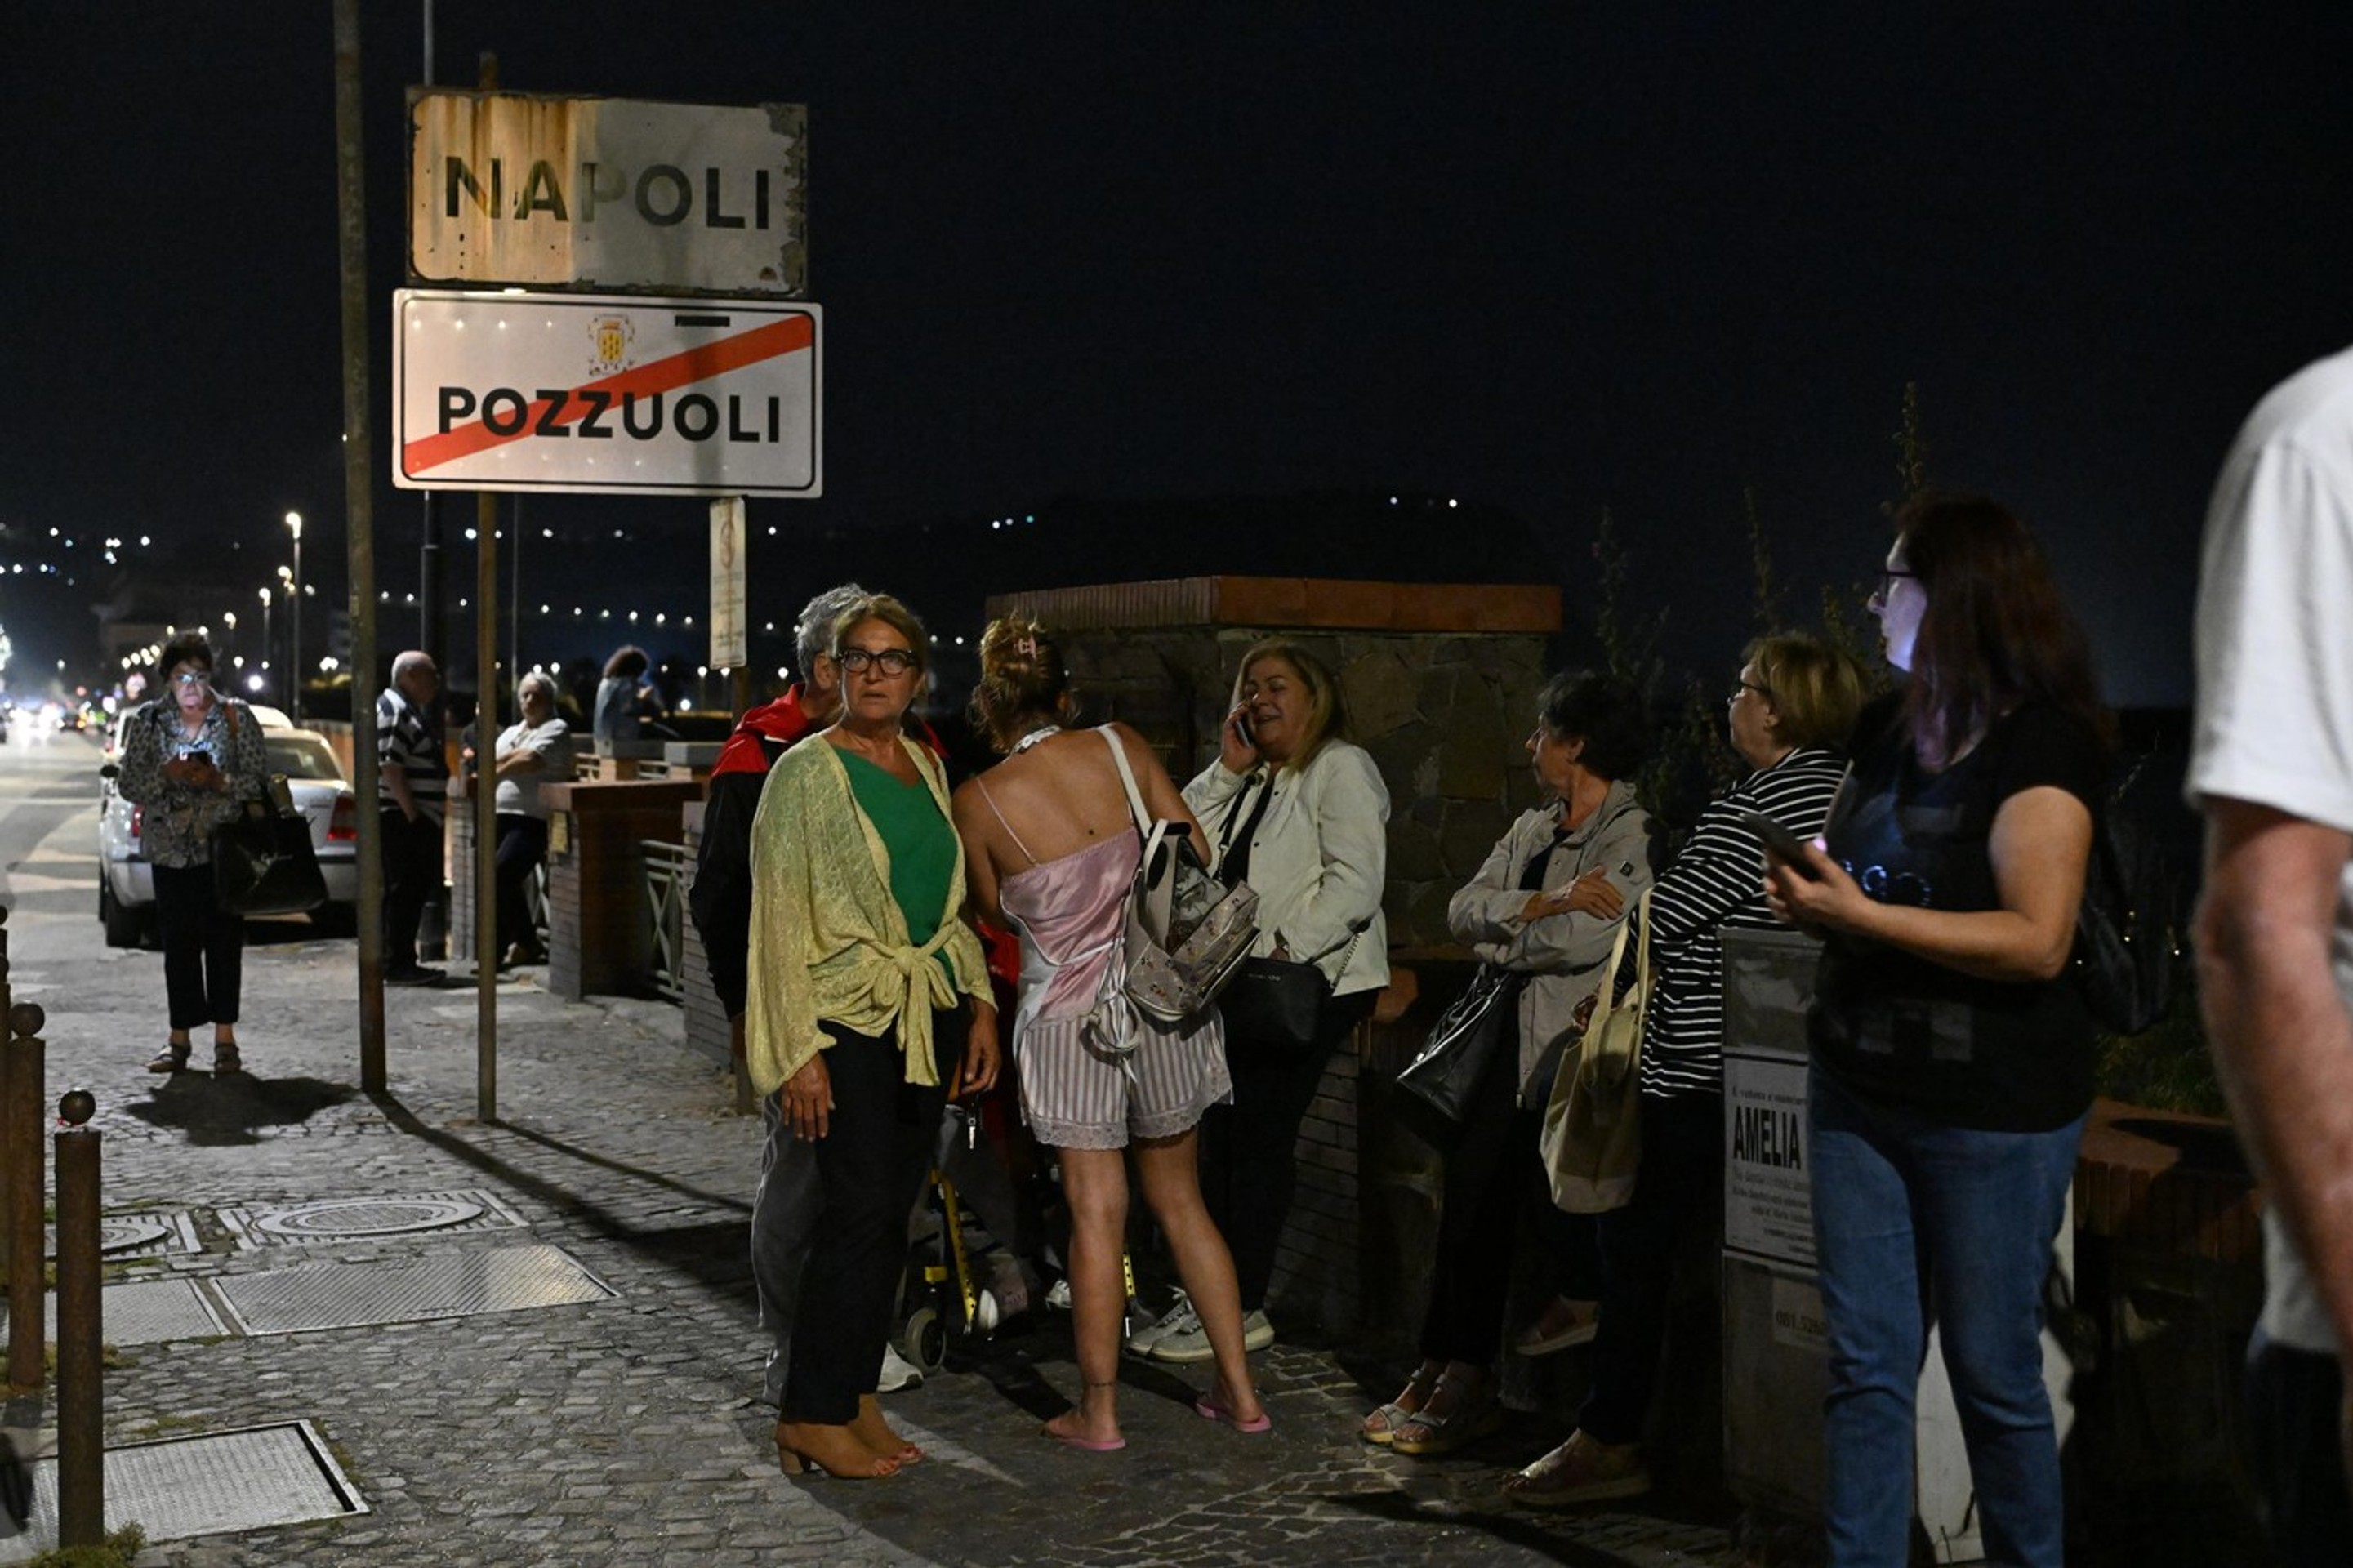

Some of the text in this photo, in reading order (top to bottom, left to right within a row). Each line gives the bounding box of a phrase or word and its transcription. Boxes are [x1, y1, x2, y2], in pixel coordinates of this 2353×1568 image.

[444, 156, 769, 230] NAPOLI
[438, 387, 780, 443] POZZUOLI
[1733, 1105, 1801, 1170] AMELIA
